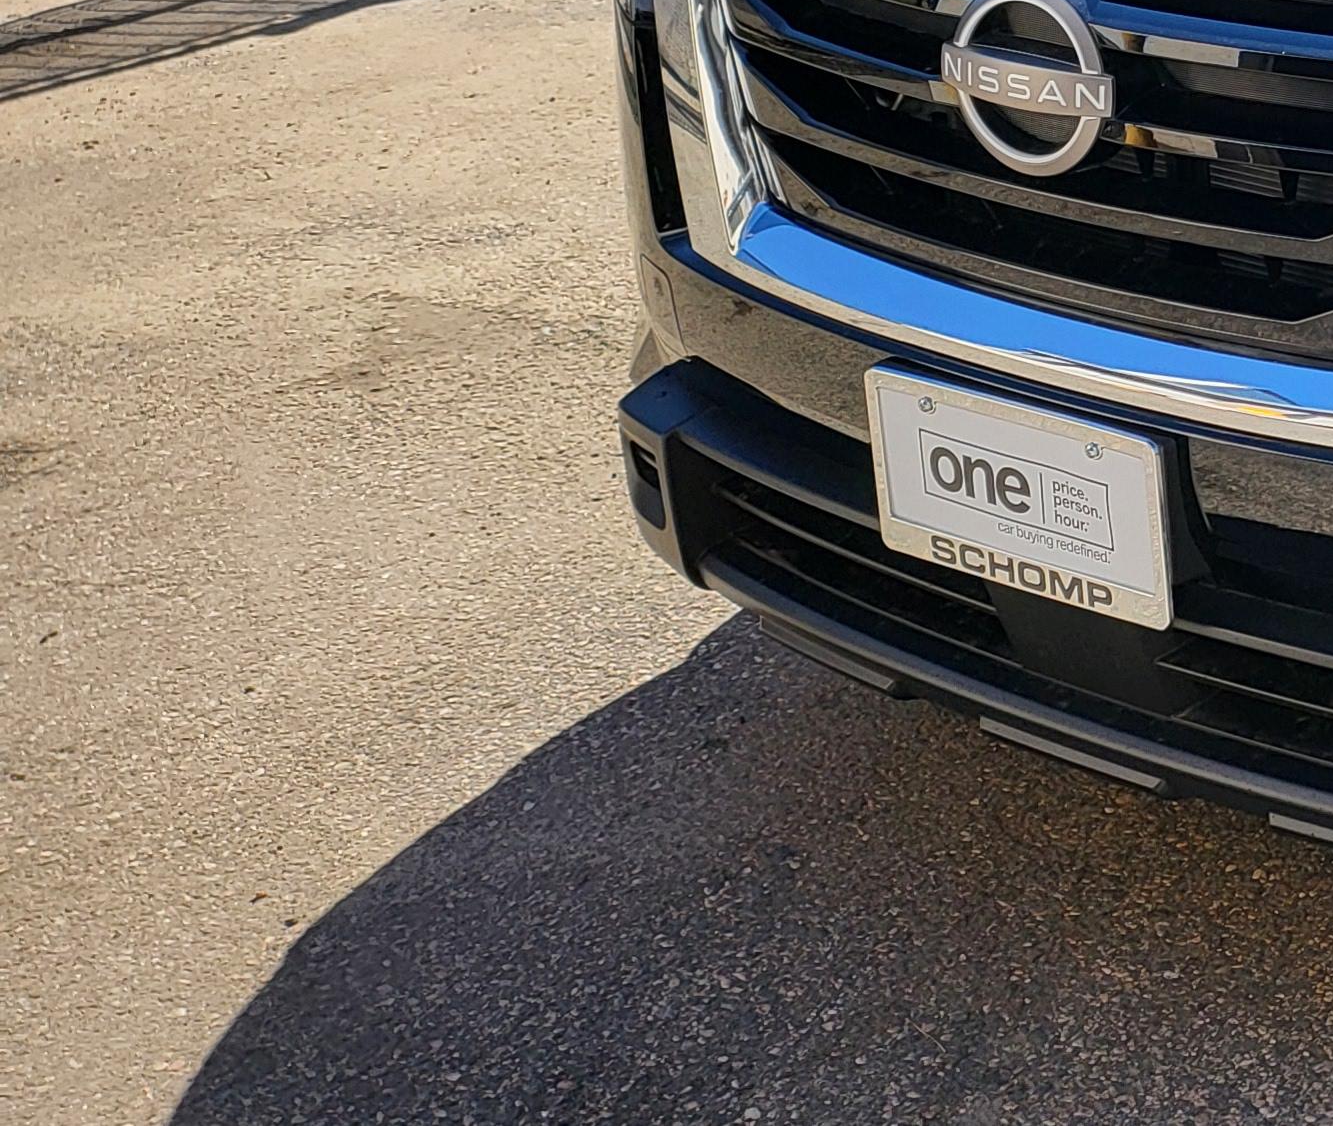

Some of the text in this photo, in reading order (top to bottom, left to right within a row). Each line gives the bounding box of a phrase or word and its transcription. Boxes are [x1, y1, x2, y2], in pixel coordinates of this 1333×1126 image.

[943, 52, 1106, 111] NISSAN
[929, 446, 1032, 514] one
[1052, 480, 1089, 502] price.
[1053, 494, 1103, 520] person.
[997, 522, 1015, 535] car
[1016, 524, 1054, 550] buying
[930, 534, 1114, 609] SCHOMP
